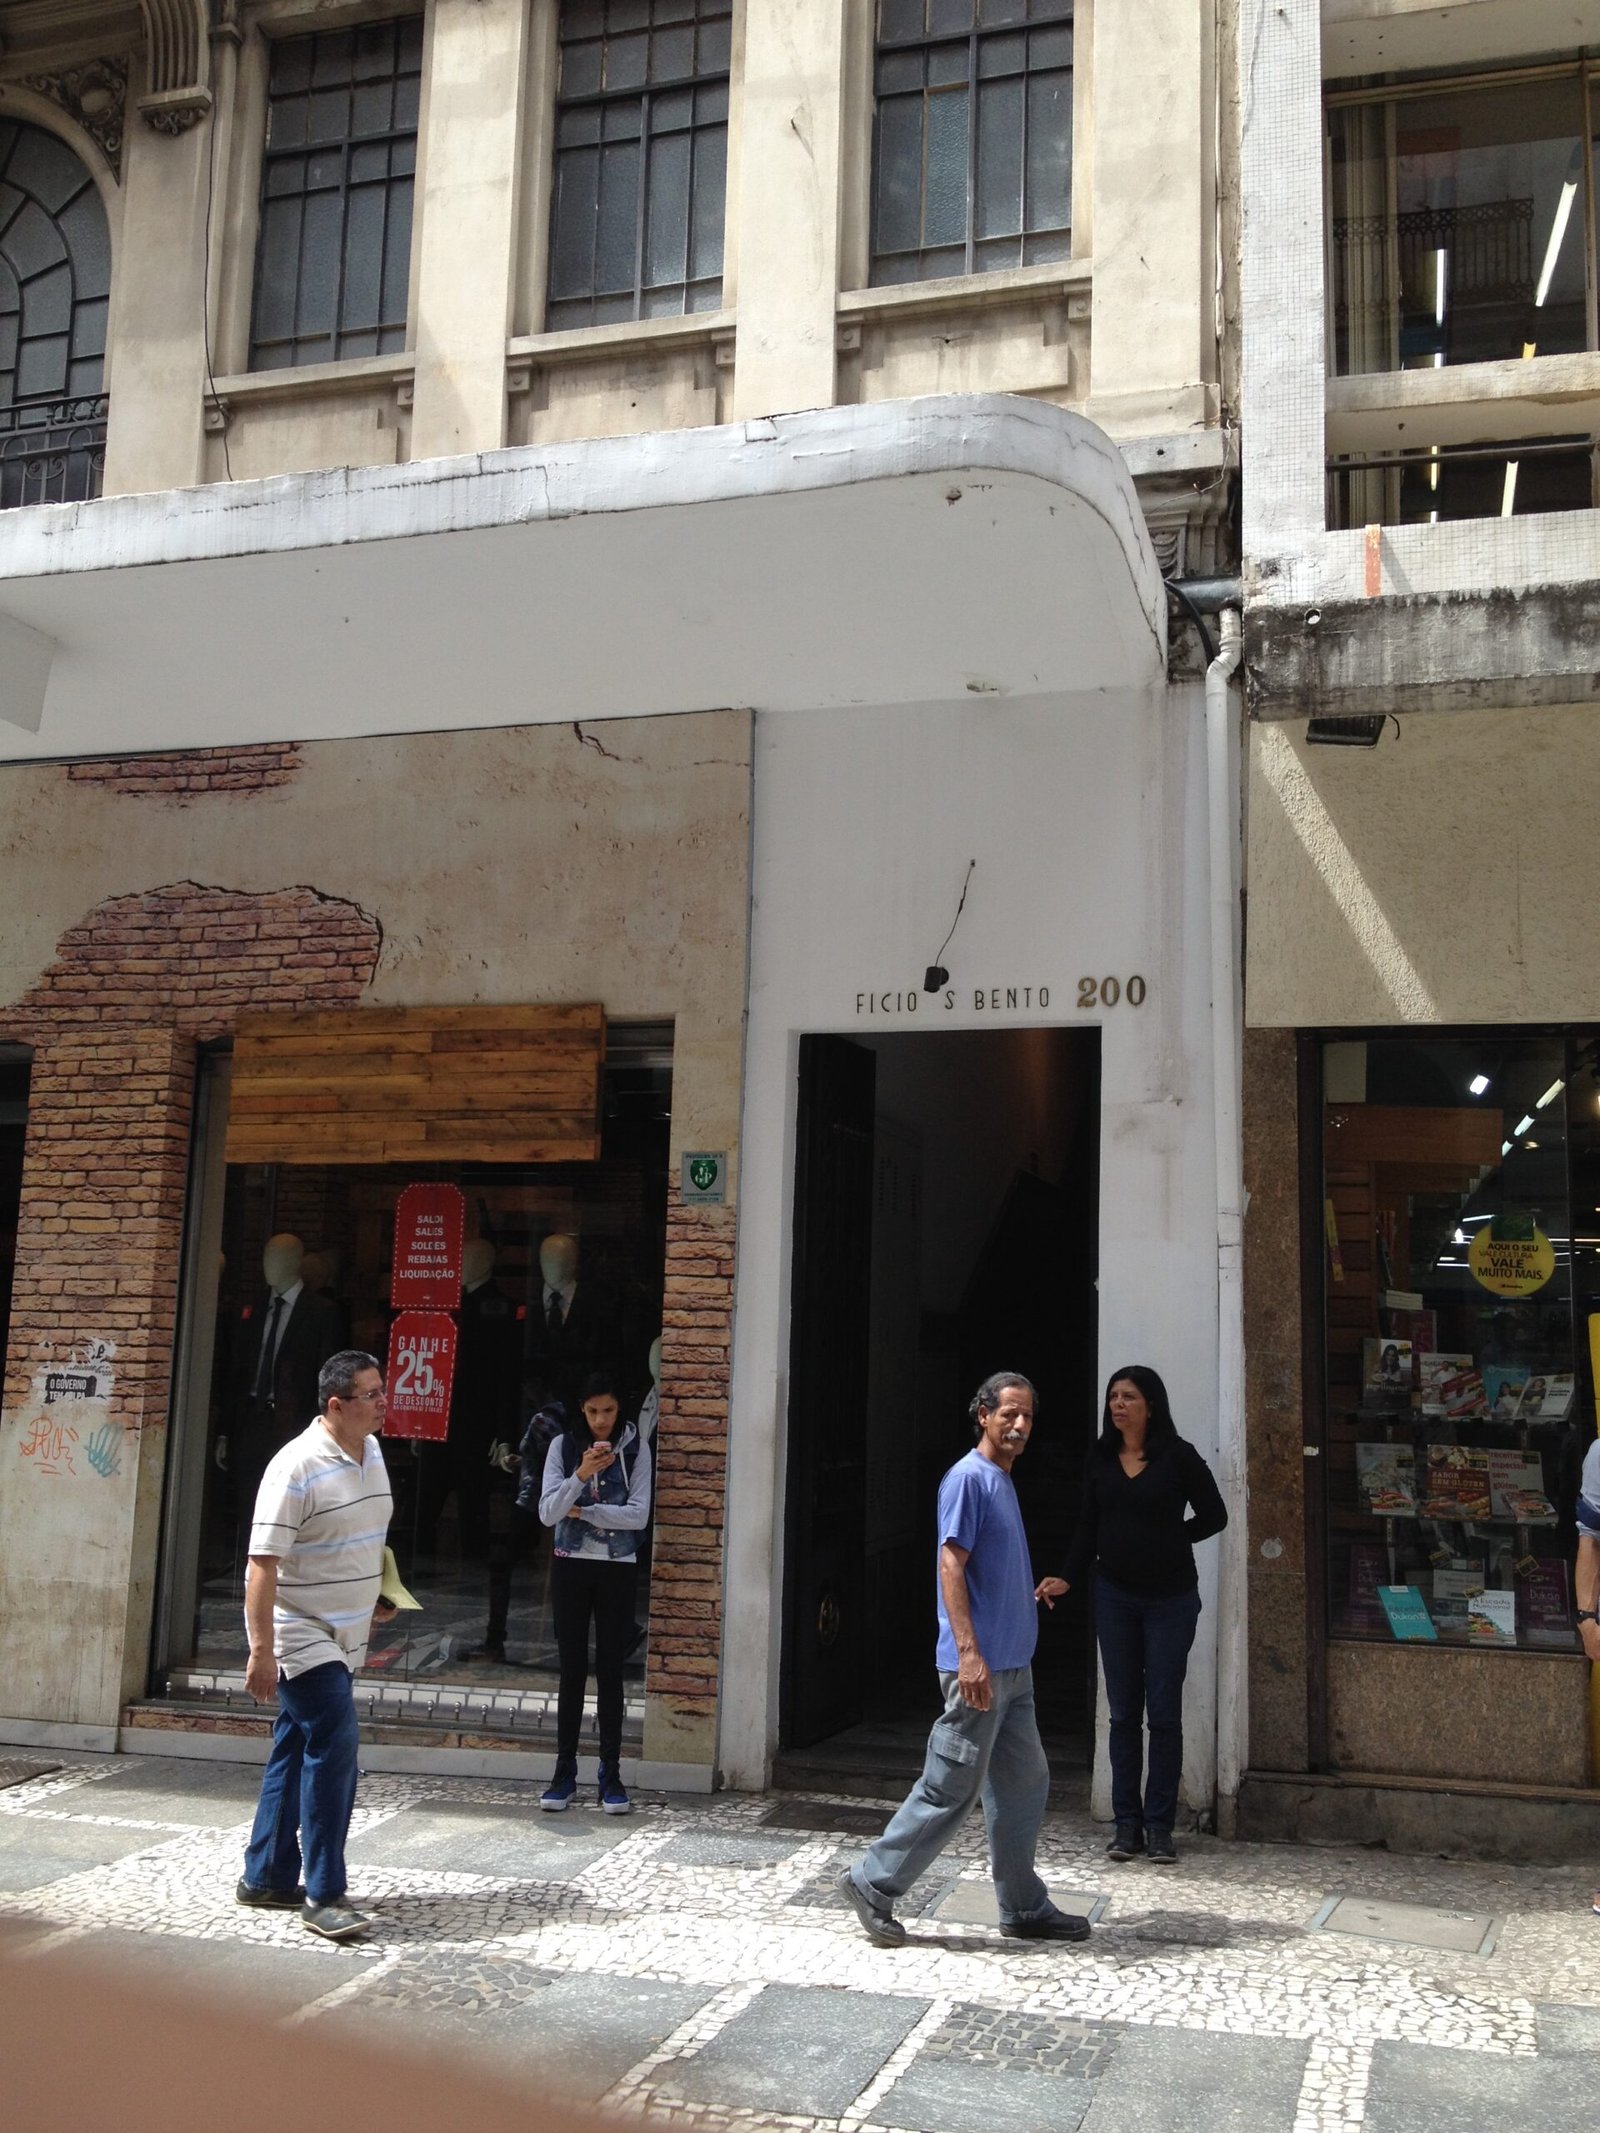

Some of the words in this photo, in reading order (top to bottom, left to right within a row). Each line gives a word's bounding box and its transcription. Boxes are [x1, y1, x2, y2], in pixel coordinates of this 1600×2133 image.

[1076, 975, 1146, 1008] 200
[856, 992, 917, 1014] FICIO
[974, 987, 1049, 1010] BENTO
[416, 1215, 444, 1224] SALDI
[415, 1227, 444, 1236] SALES
[410, 1241, 446, 1250] SOLDES
[1487, 1243, 1511, 1251] AQUI
[407, 1254, 449, 1264] REBAJAS
[1491, 1258, 1524, 1269] VALE
[399, 1267, 455, 1280] LIQUIDAÇÃO
[1477, 1267, 1513, 1278] MUITO
[398, 1336, 449, 1353] GANHE
[50, 1379, 55, 1389] O
[56, 1379, 87, 1390] GOVERNO
[393, 1395, 404, 1404] DE
[405, 1396, 444, 1407] DESCONTO
[1529, 1588, 1560, 1601] Dukan
